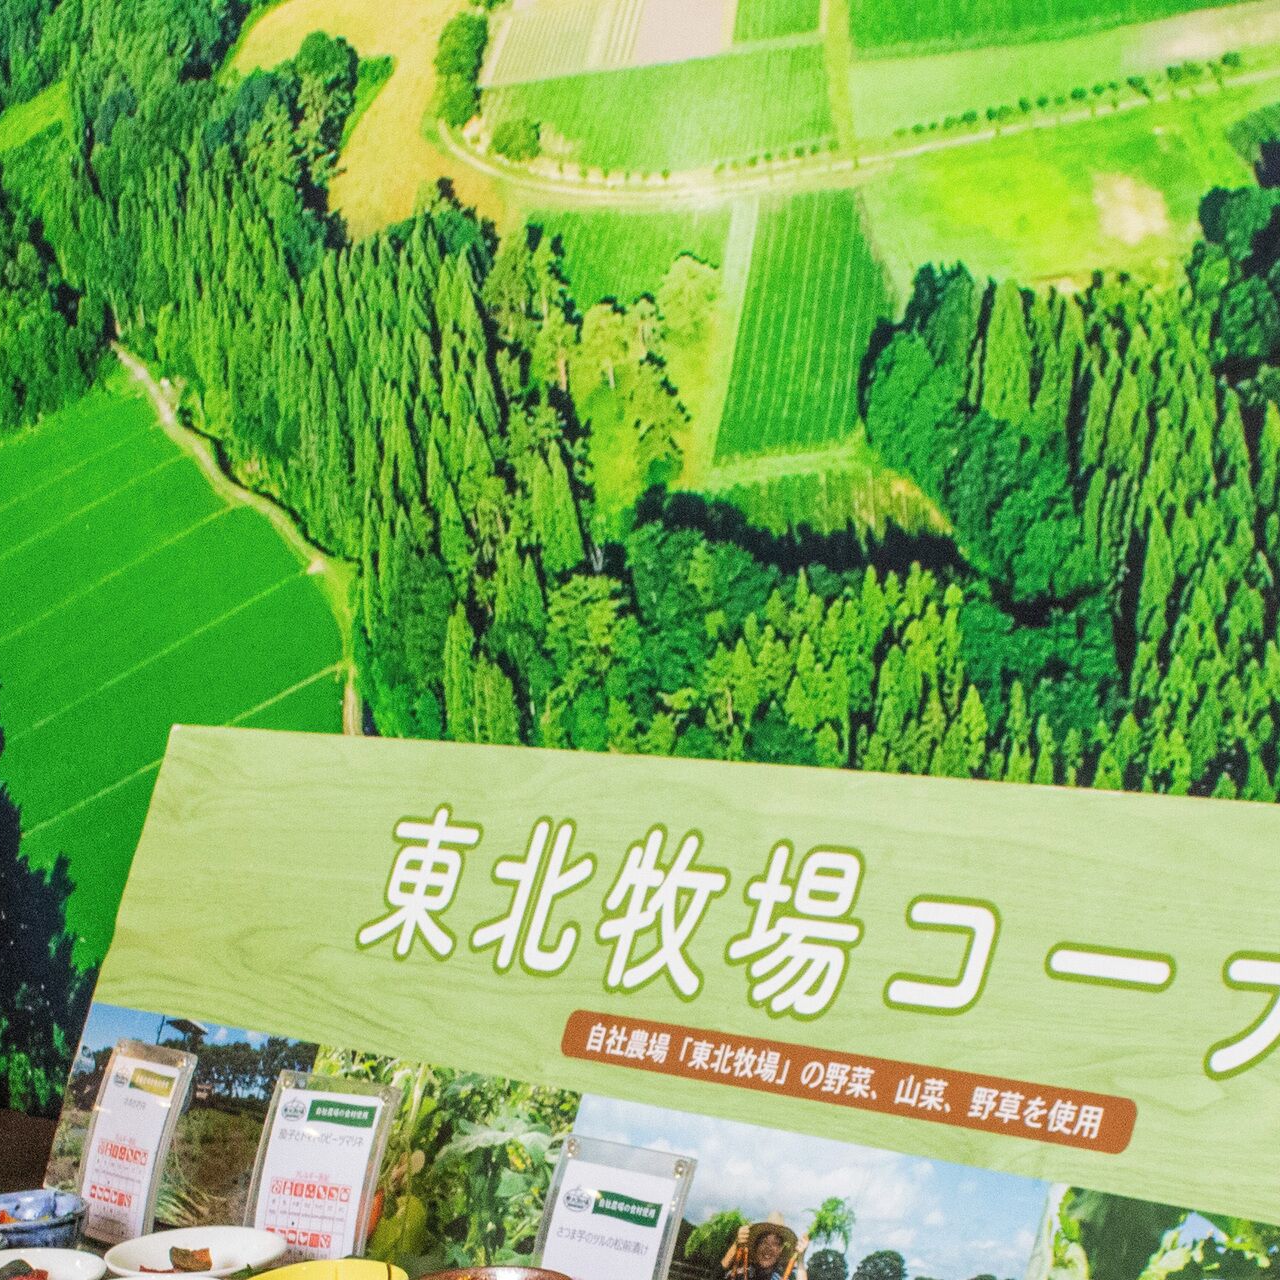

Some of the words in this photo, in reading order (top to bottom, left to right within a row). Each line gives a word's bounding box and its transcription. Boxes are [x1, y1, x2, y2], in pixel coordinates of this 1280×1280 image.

[585, 1022, 1104, 1140] 自社農場「東北牧場」の野菜、山菜、野草を使用
